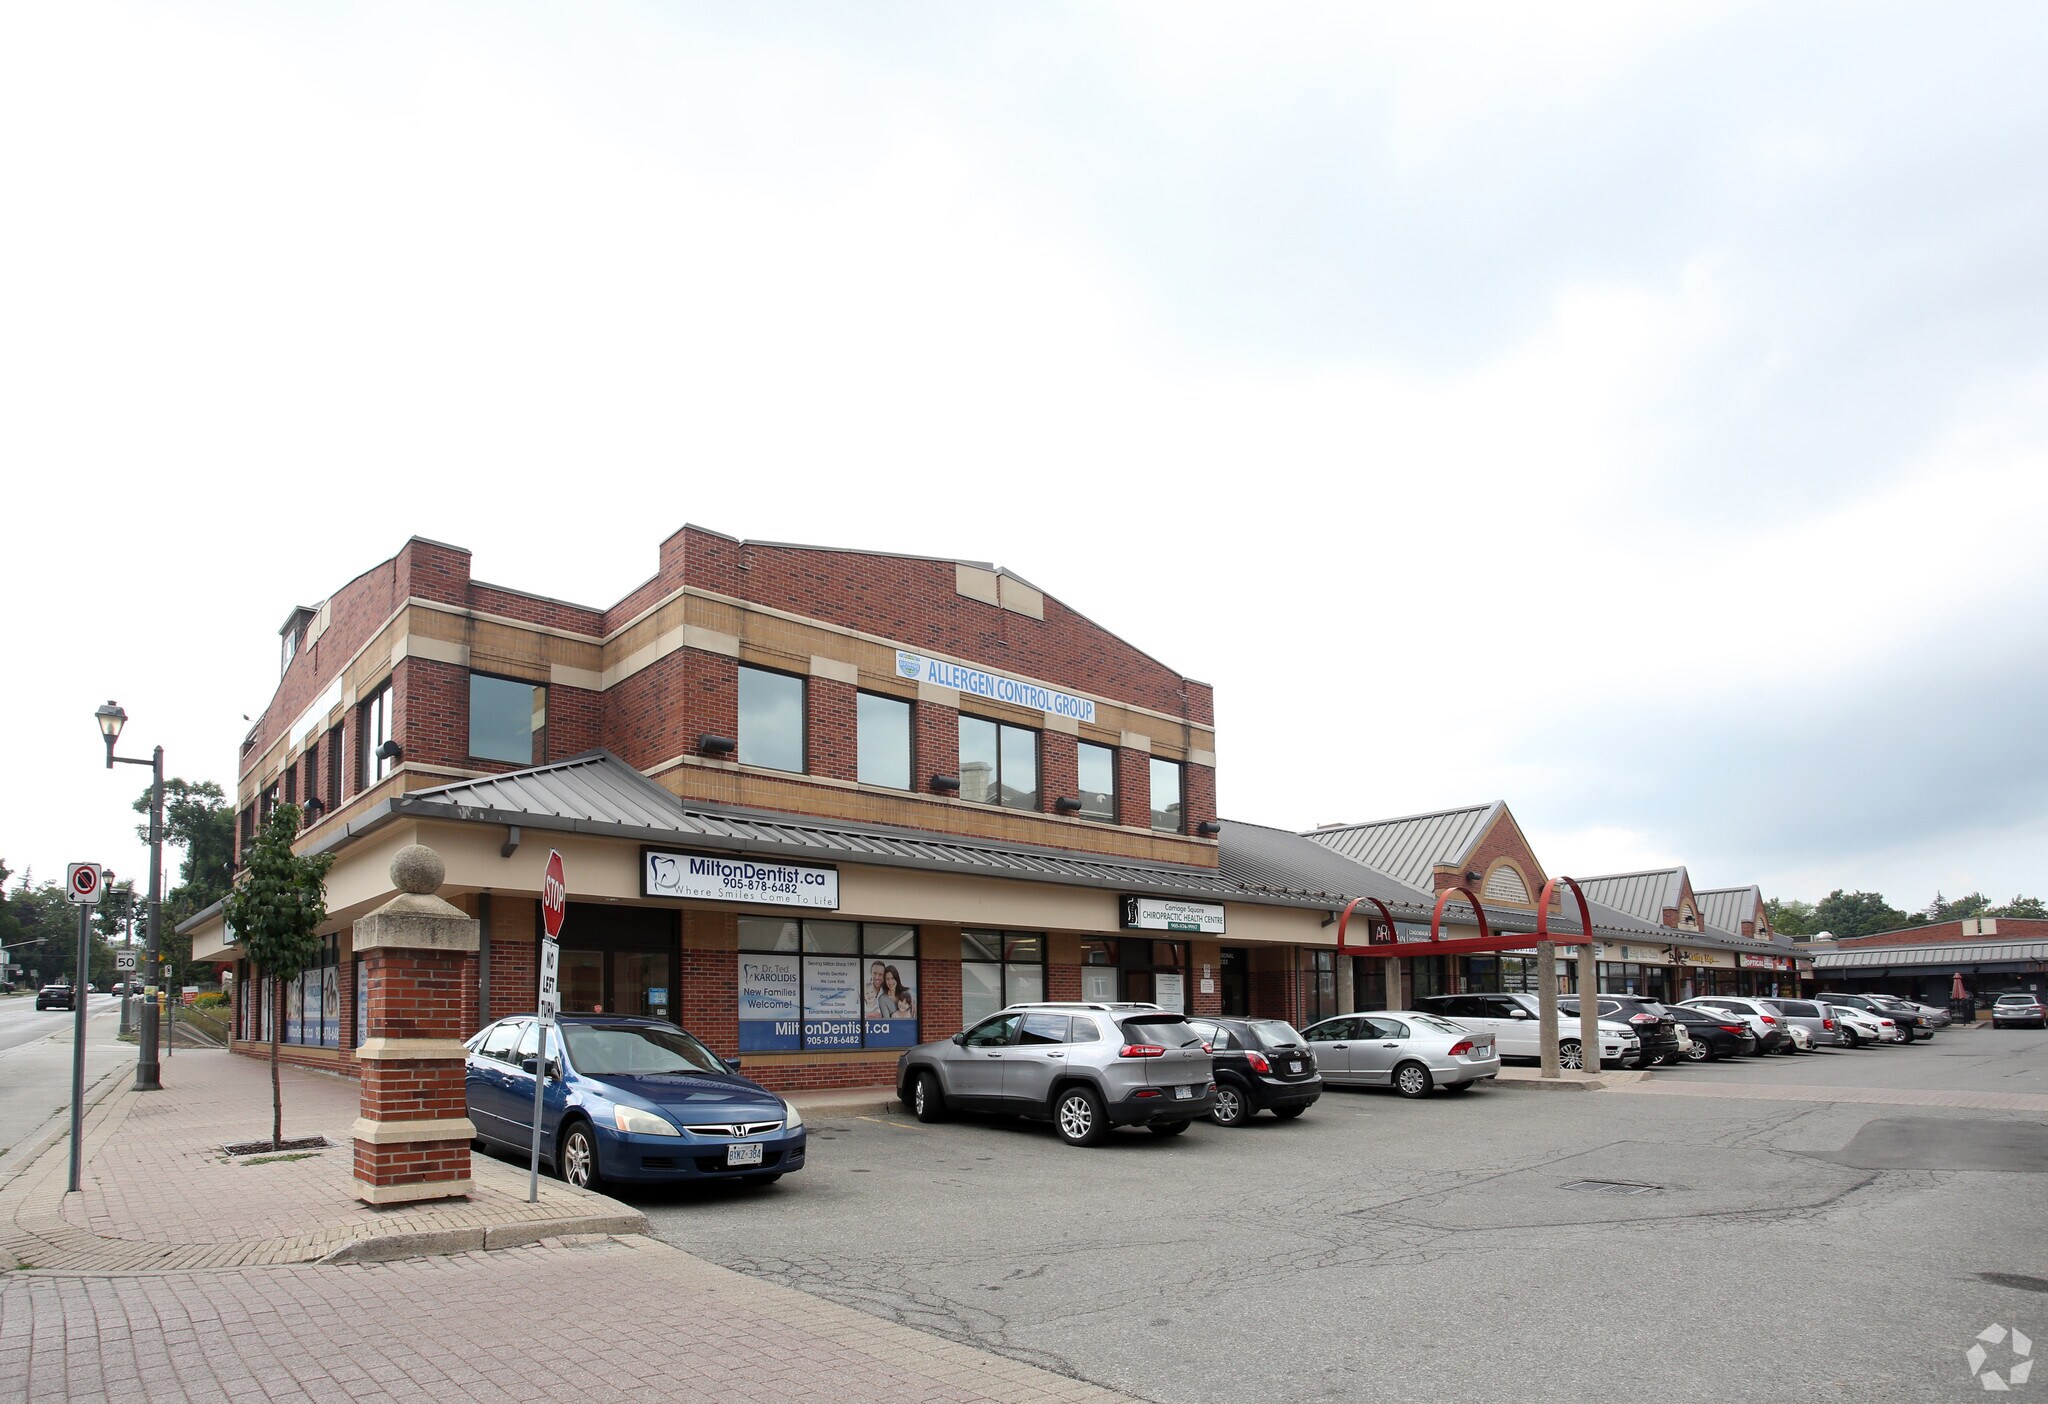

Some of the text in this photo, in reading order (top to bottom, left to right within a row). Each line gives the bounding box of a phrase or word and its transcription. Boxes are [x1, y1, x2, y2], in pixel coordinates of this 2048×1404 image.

[928, 660, 1092, 721] ALLERGEN CONTROL GROUP
[690, 858, 825, 886] MiltonDentist.ca
[723, 877, 798, 894] 905-878-6482
[545, 874, 564, 914] STOP
[674, 885, 837, 906] Where Smiles Come To Life!
[1164, 903, 1205, 914] Carriage Square
[1142, 910, 1223, 925] CHIROPRACTIC HEALTH CENTRE
[118, 957, 135, 968] 50
[546, 950, 555, 970] NO
[1746, 959, 1764, 968] OPTICAL
[762, 964, 789, 973] Dr. Ted
[543, 975, 555, 995] LEFT
[754, 973, 797, 983] KAROLIDIS
[743, 988, 797, 996] New Families
[541, 1000, 555, 1020] TURN
[748, 1000, 792, 1009] Welcome!
[775, 1021, 890, 1035] MiltonDentist.ca
[806, 1035, 860, 1045] 905-878-6482
